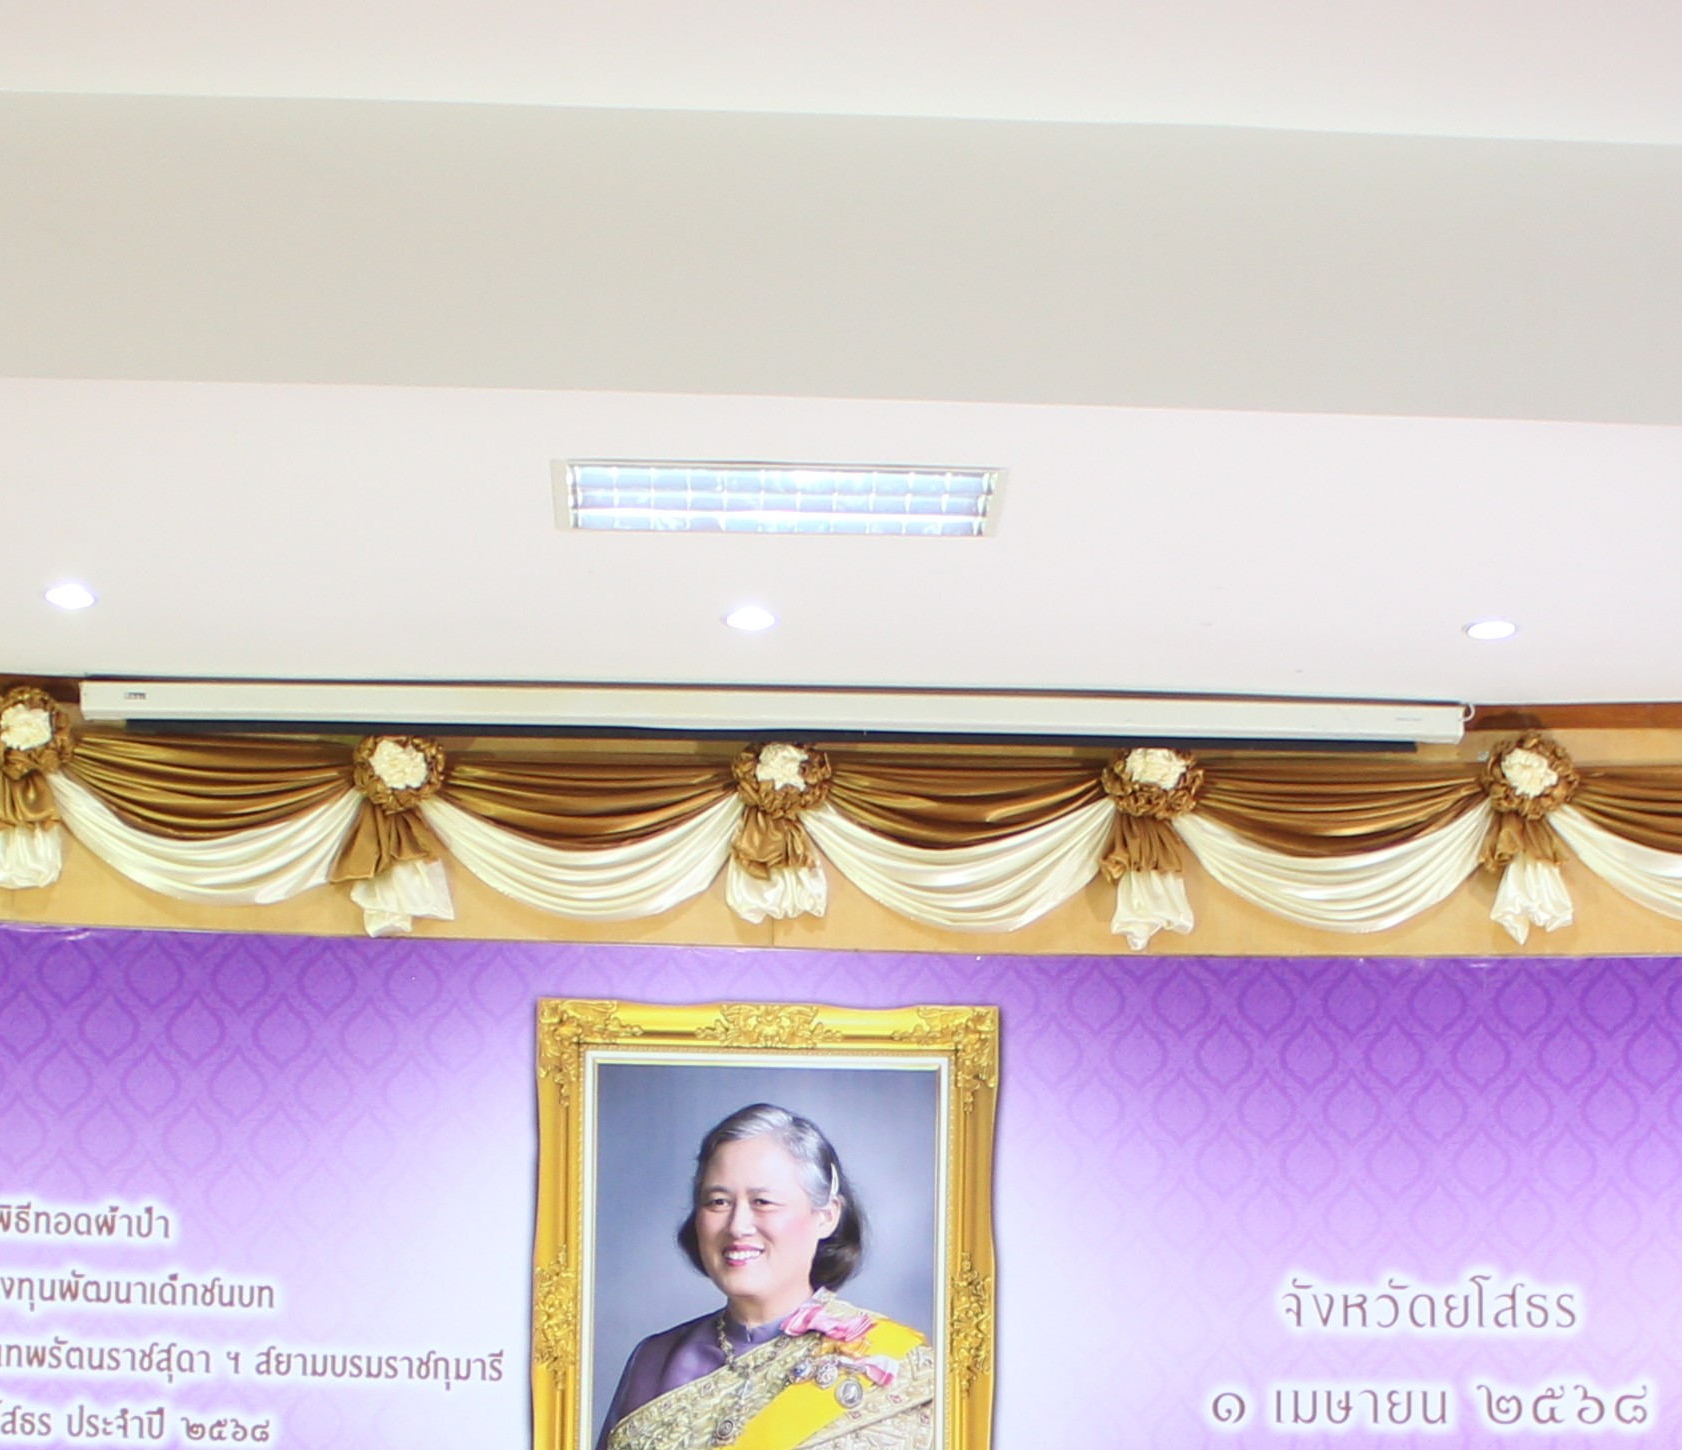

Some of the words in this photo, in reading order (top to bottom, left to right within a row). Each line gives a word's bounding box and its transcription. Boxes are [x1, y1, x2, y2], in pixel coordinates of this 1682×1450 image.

[1280, 1275, 1577, 1329] จังหวัดยโสธร
[225, 1350, 241, 1375] ฯ
[254, 1344, 505, 1392] สยามบรมราชกุมารี
[66, 1404, 166, 1440] ประจำปี
[180, 1416, 271, 1443] ๒๕๖๘
[1211, 1391, 1247, 1424] ๑
[1274, 1389, 1448, 1425] เมษายน
[1476, 1384, 1649, 1425] ๒๕๖๘
